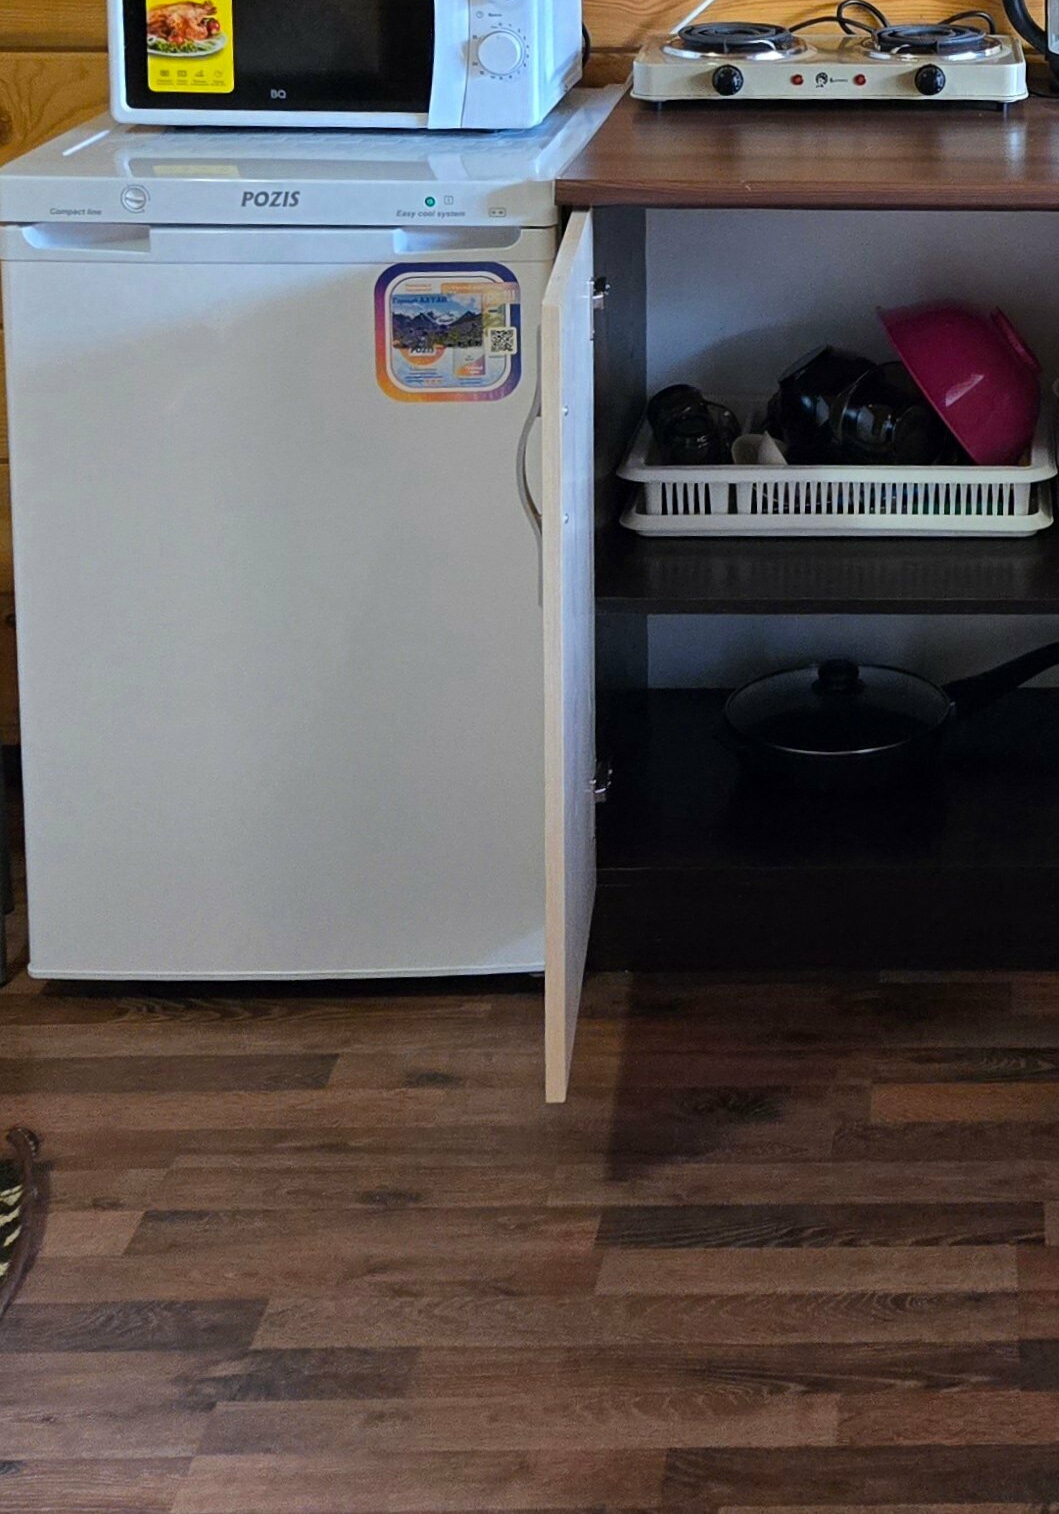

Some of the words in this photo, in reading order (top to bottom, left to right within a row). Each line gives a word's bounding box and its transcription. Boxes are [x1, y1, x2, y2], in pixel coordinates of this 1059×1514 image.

[271, 89, 287, 99] BQ
[241, 191, 301, 207] POZIS
[50, 208, 85, 216] Compact
[396, 209, 415, 218] Easy
[417, 209, 435, 217] cool
[437, 210, 466, 218] system
